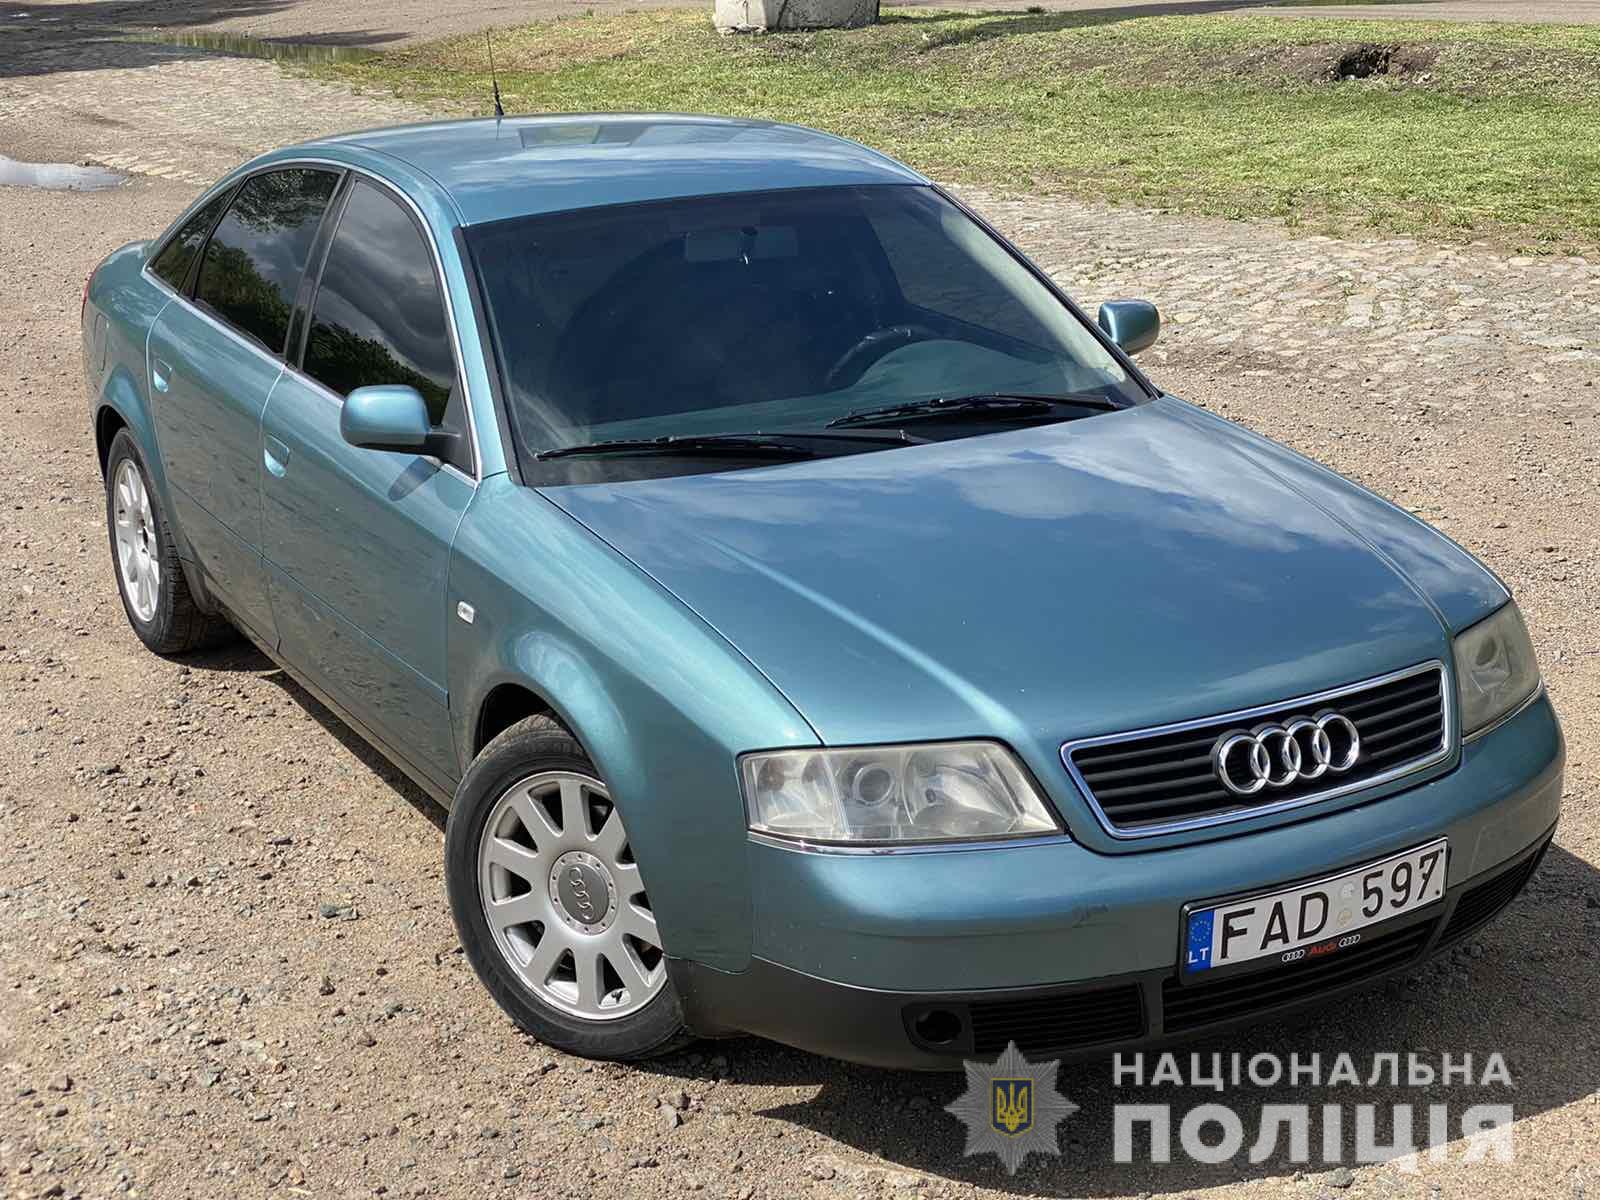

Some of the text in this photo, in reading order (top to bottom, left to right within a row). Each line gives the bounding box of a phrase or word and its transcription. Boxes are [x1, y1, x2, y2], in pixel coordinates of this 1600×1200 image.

[1220, 850, 1439, 959] FAD 597
[1188, 946, 1209, 964] LT
